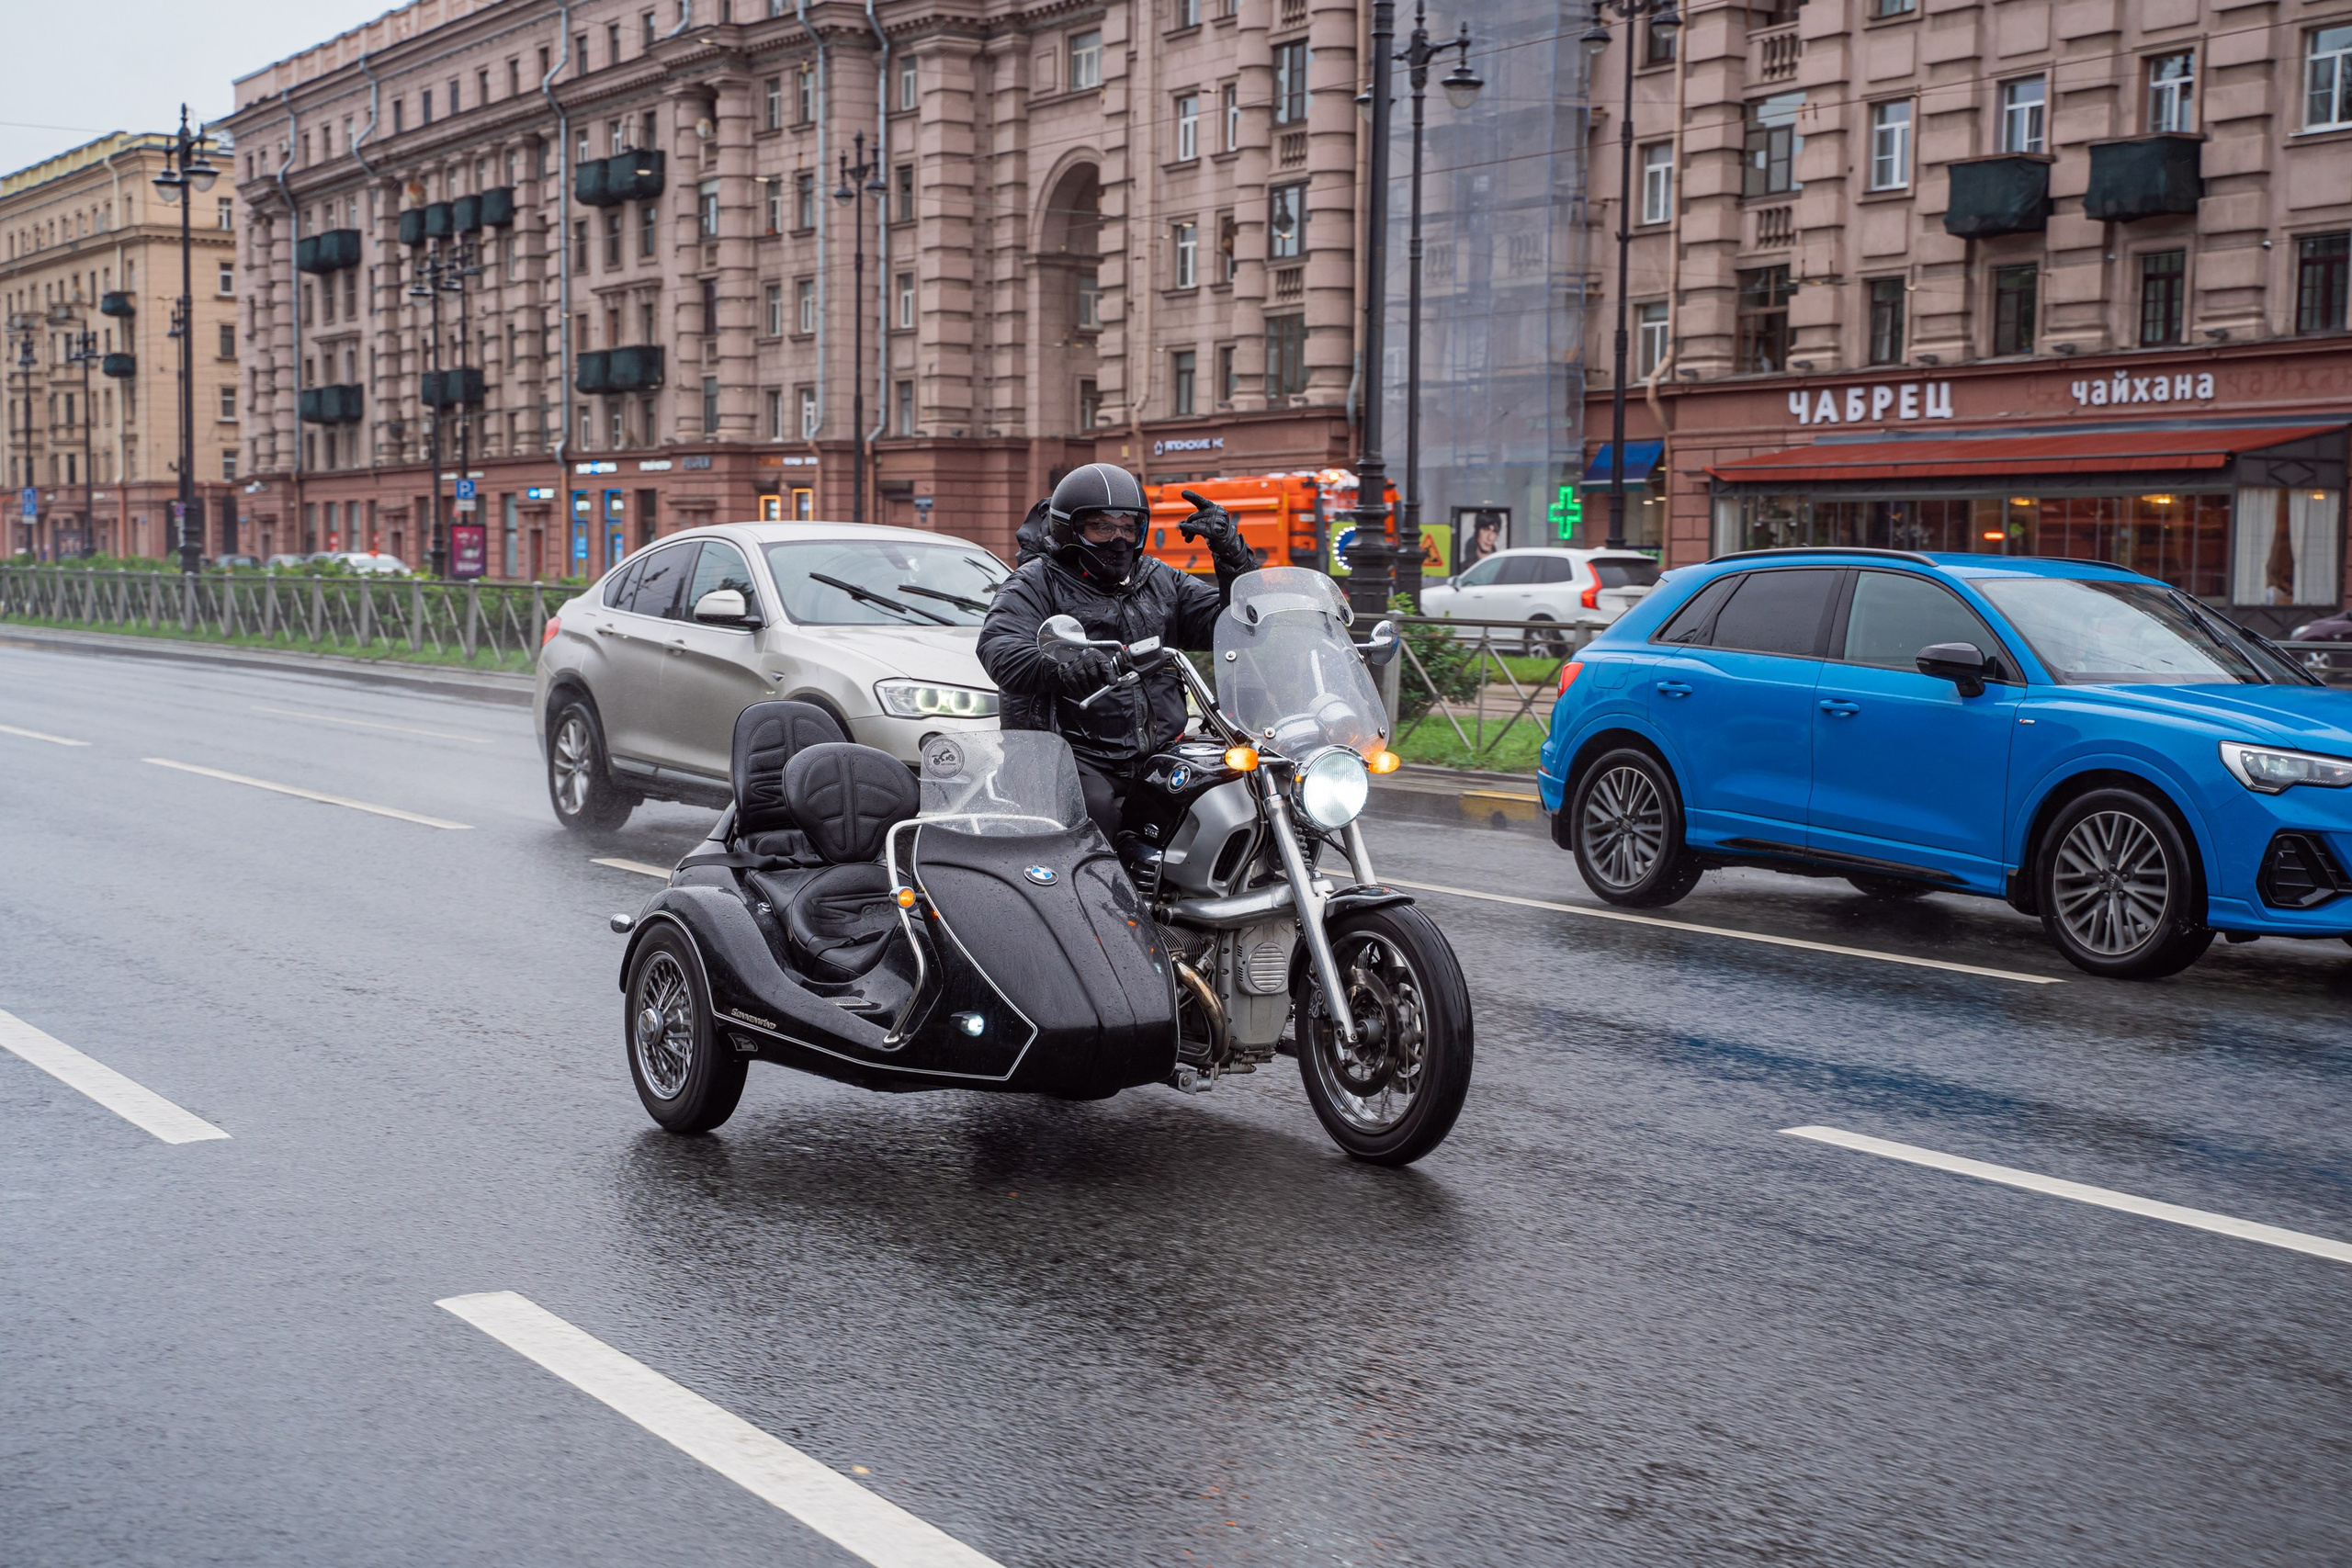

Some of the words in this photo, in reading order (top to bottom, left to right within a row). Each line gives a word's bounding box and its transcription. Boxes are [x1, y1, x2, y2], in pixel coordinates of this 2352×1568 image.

[1788, 382, 1953, 424] ЧАБРЕЦ
[2072, 370, 2214, 405] чайхана
[460, 481, 471, 493] P
